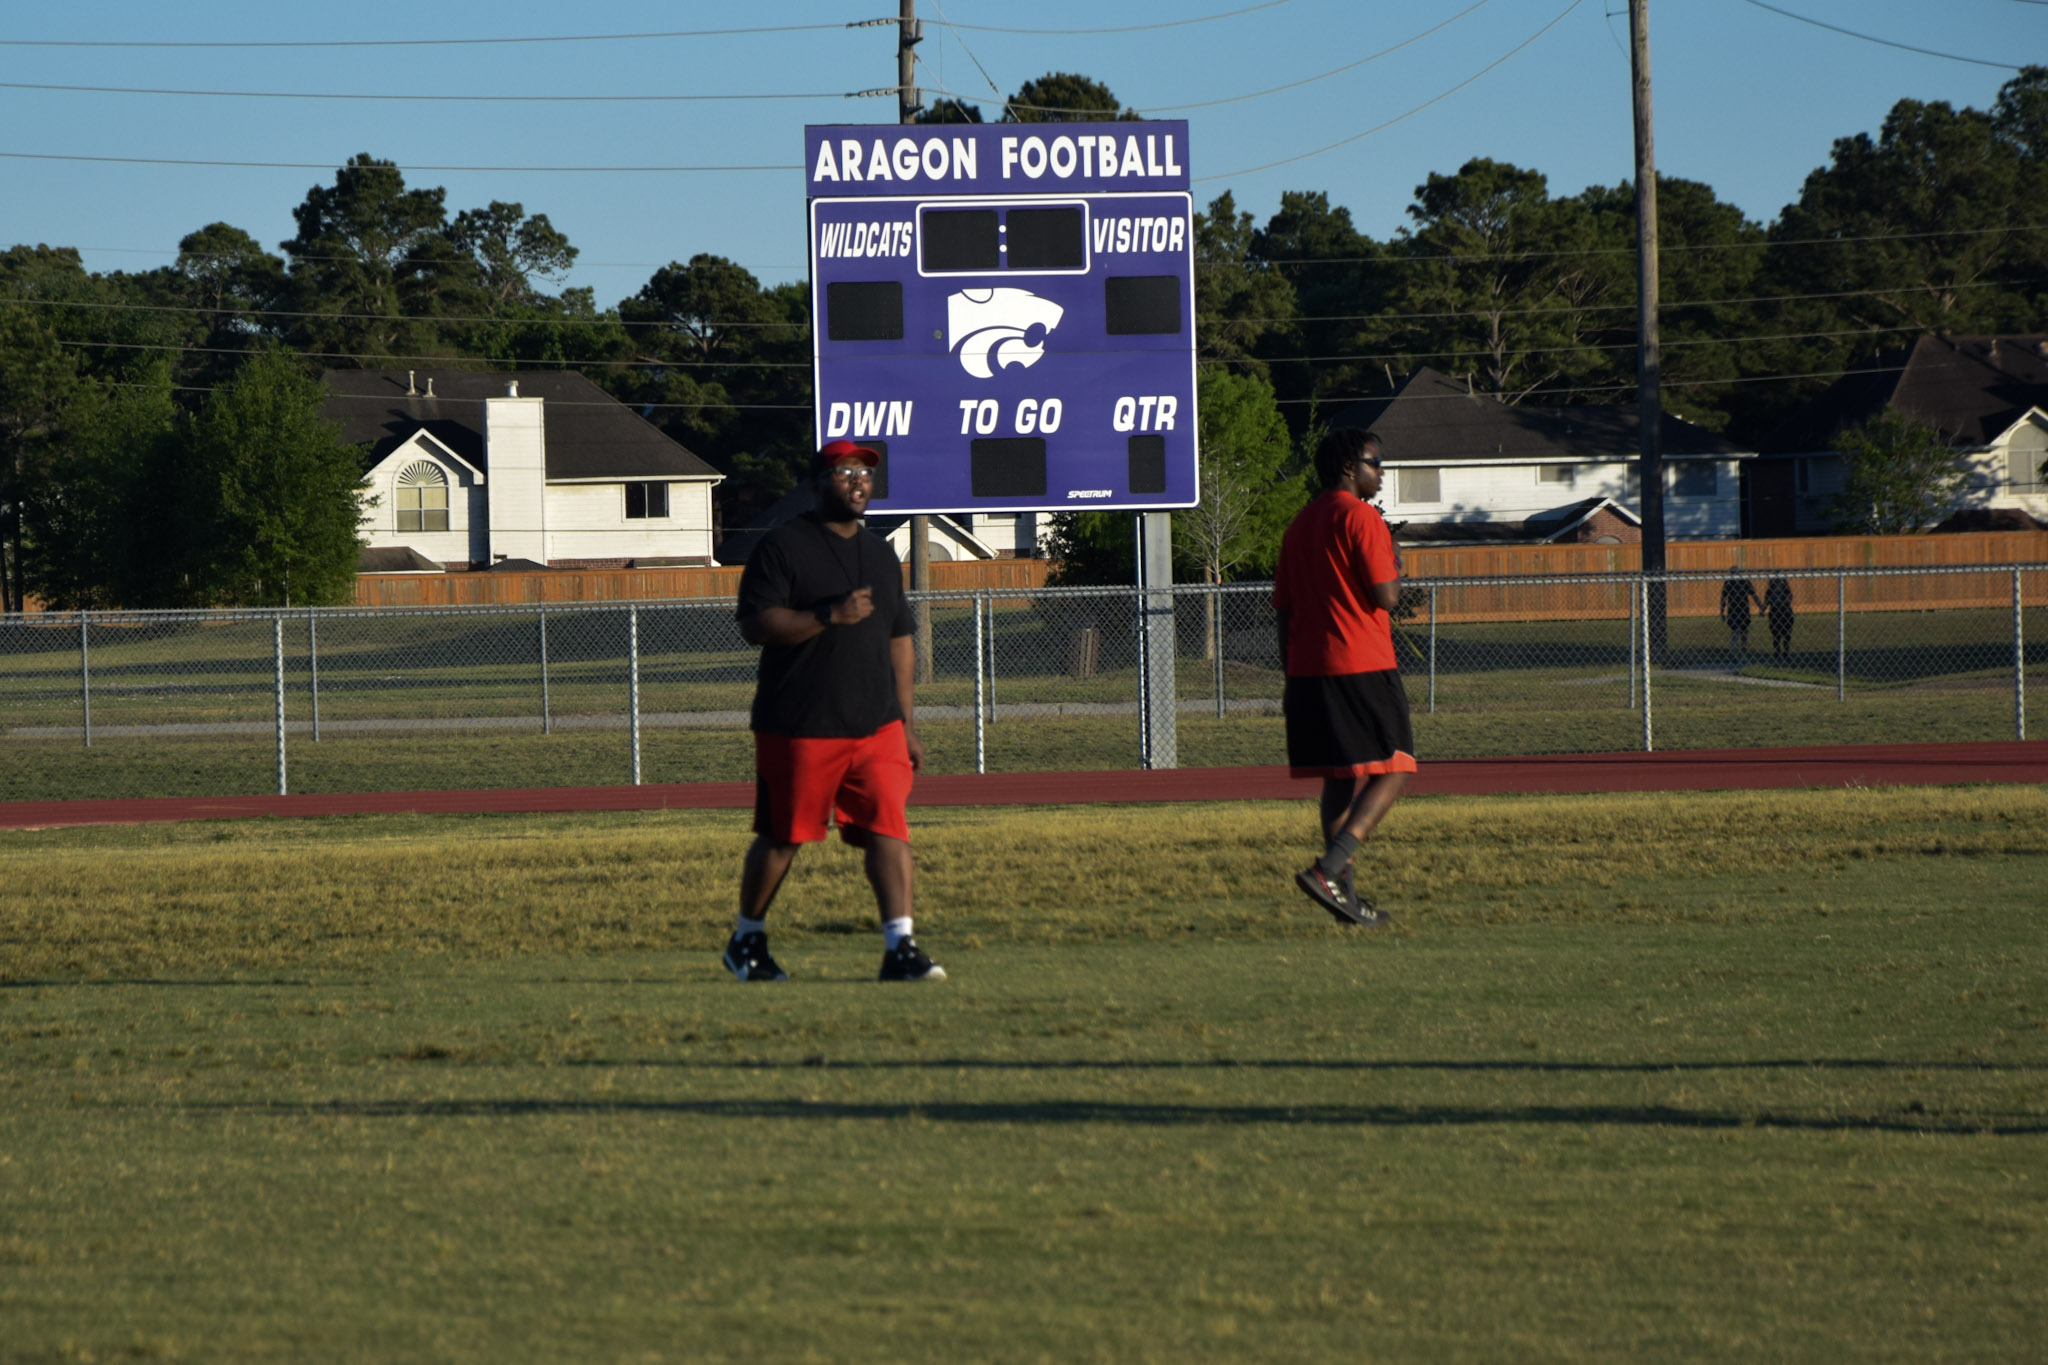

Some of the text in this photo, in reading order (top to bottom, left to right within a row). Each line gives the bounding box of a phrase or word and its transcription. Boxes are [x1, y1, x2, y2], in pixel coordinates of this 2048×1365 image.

[813, 134, 1182, 182] ARAGON FOOTBALL
[819, 221, 913, 258] WILDCATS
[1093, 216, 1185, 253] VISITOR
[826, 400, 913, 438] DWN
[959, 397, 1063, 435] TO GO
[1112, 395, 1178, 432] QTR
[1067, 489, 1112, 499] SPECTRUM
